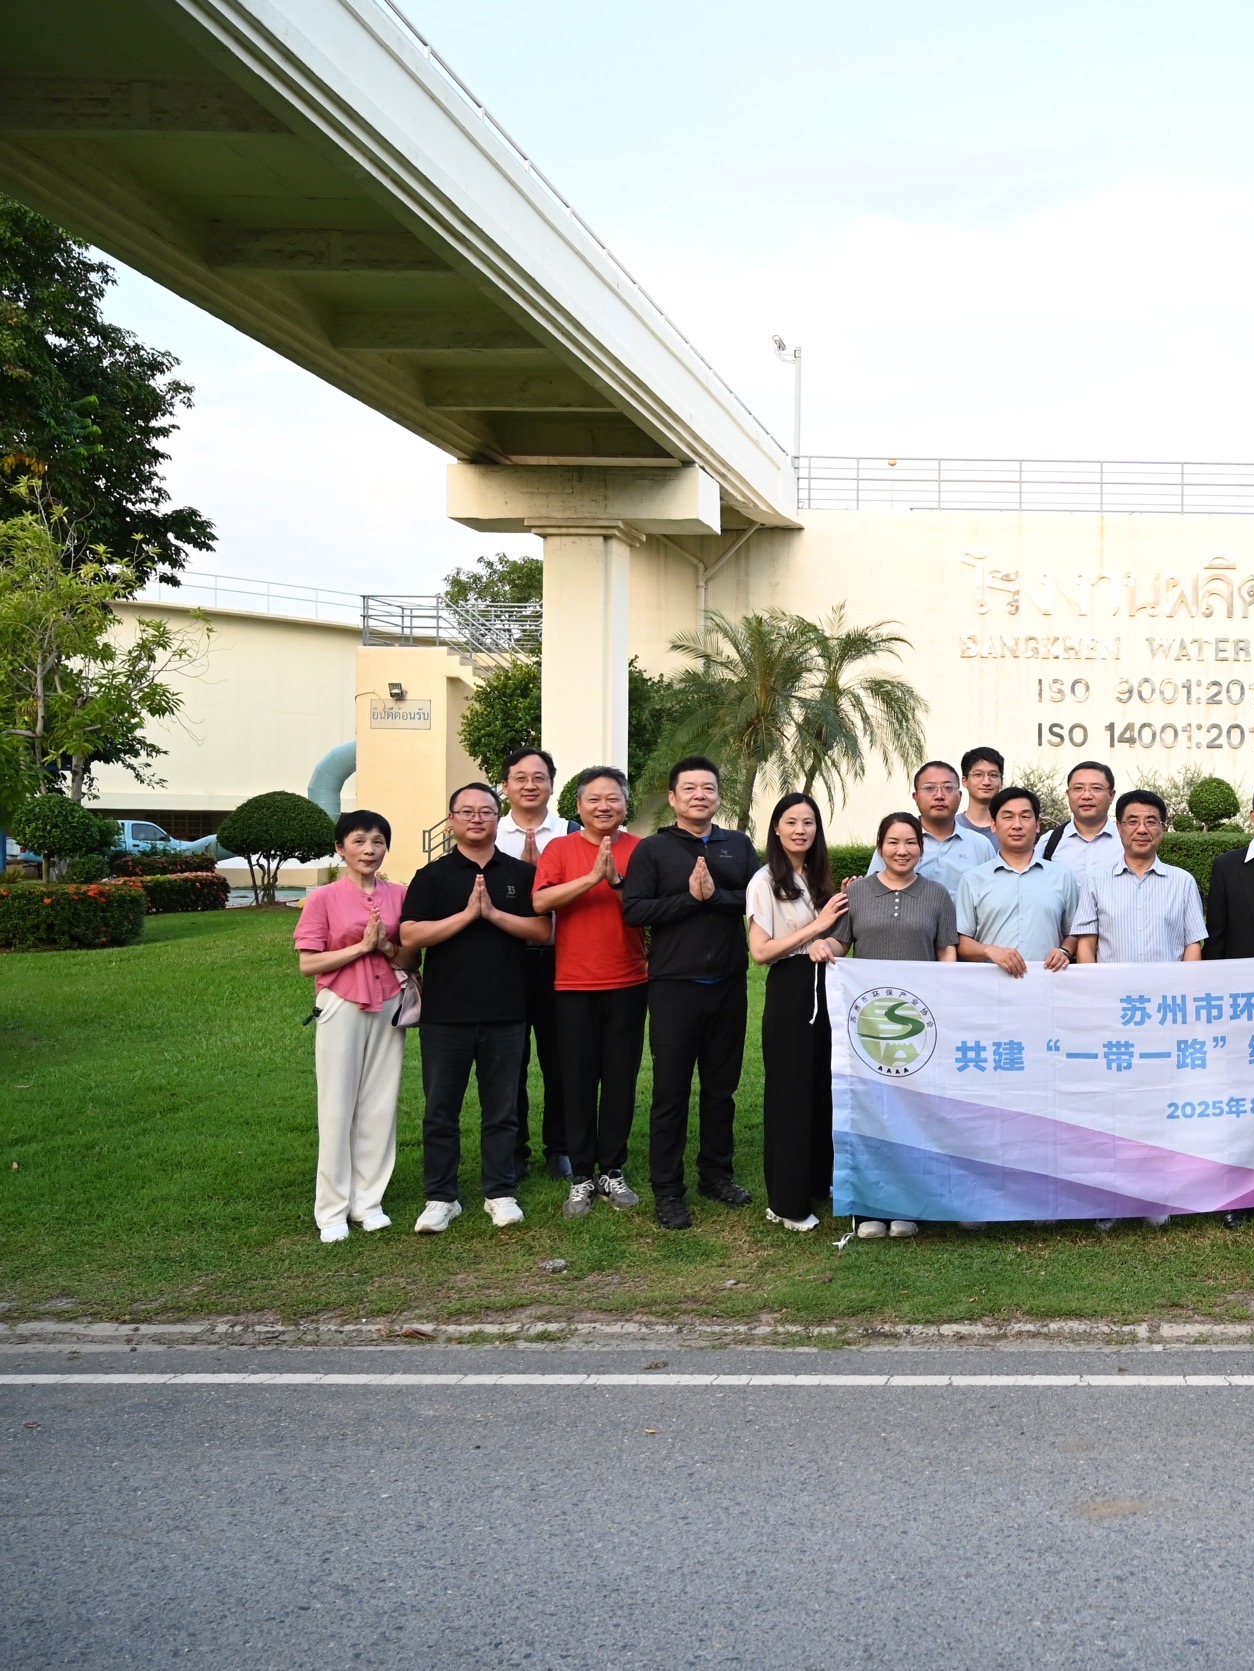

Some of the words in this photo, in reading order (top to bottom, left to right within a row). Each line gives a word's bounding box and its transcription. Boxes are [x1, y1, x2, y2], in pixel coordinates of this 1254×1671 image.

[960, 635, 1120, 660] BANGKHEN
[1146, 637, 1251, 662] WATER
[1037, 678, 1090, 703] ISO
[372, 707, 430, 721] ยินดีต้อนรับ
[1037, 722, 1088, 748] ISO
